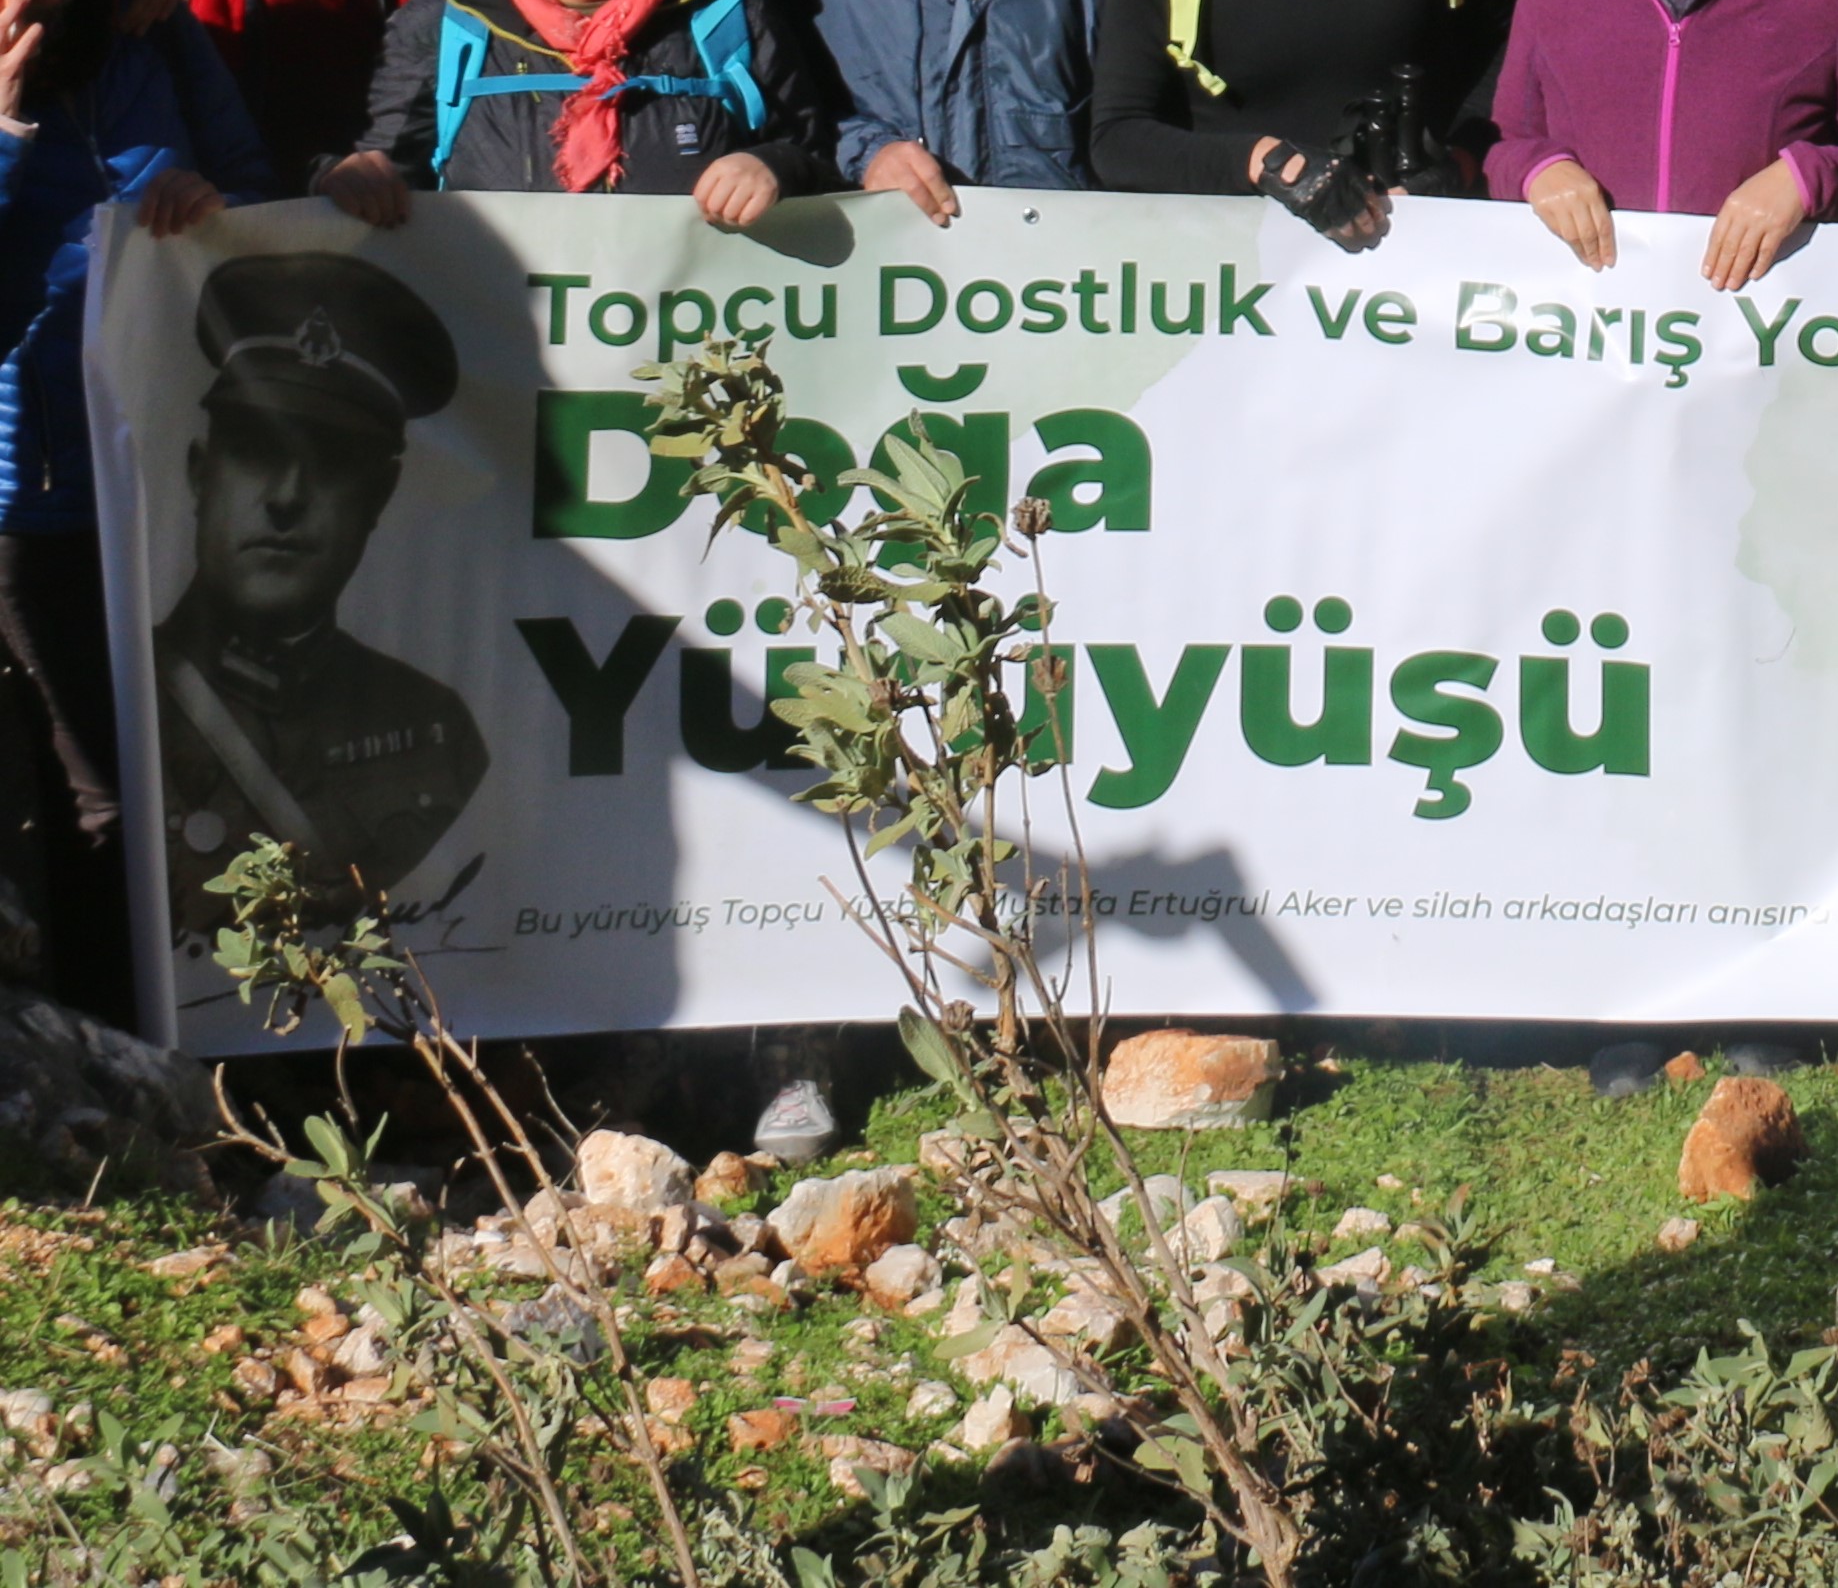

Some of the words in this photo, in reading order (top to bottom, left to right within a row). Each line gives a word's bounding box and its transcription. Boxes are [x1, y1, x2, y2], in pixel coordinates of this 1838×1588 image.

[528, 272, 839, 364] Topçu
[880, 261, 1277, 337] Dostluk
[1305, 284, 1417, 346] ve
[1455, 280, 1703, 389] Barış
[532, 363, 1153, 572] Doğa
[515, 591, 1652, 820] Yüüyüşü
[514, 908, 561, 935] Bu
[568, 900, 711, 939] yürüyüş
[722, 898, 823, 931] Topçu
[1128, 889, 1271, 922] Ertuğrul
[1276, 889, 1357, 917] Aker
[1364, 896, 1404, 918] ve
[1411, 891, 1492, 920] silah
[1503, 893, 1697, 930] arkadaşları
